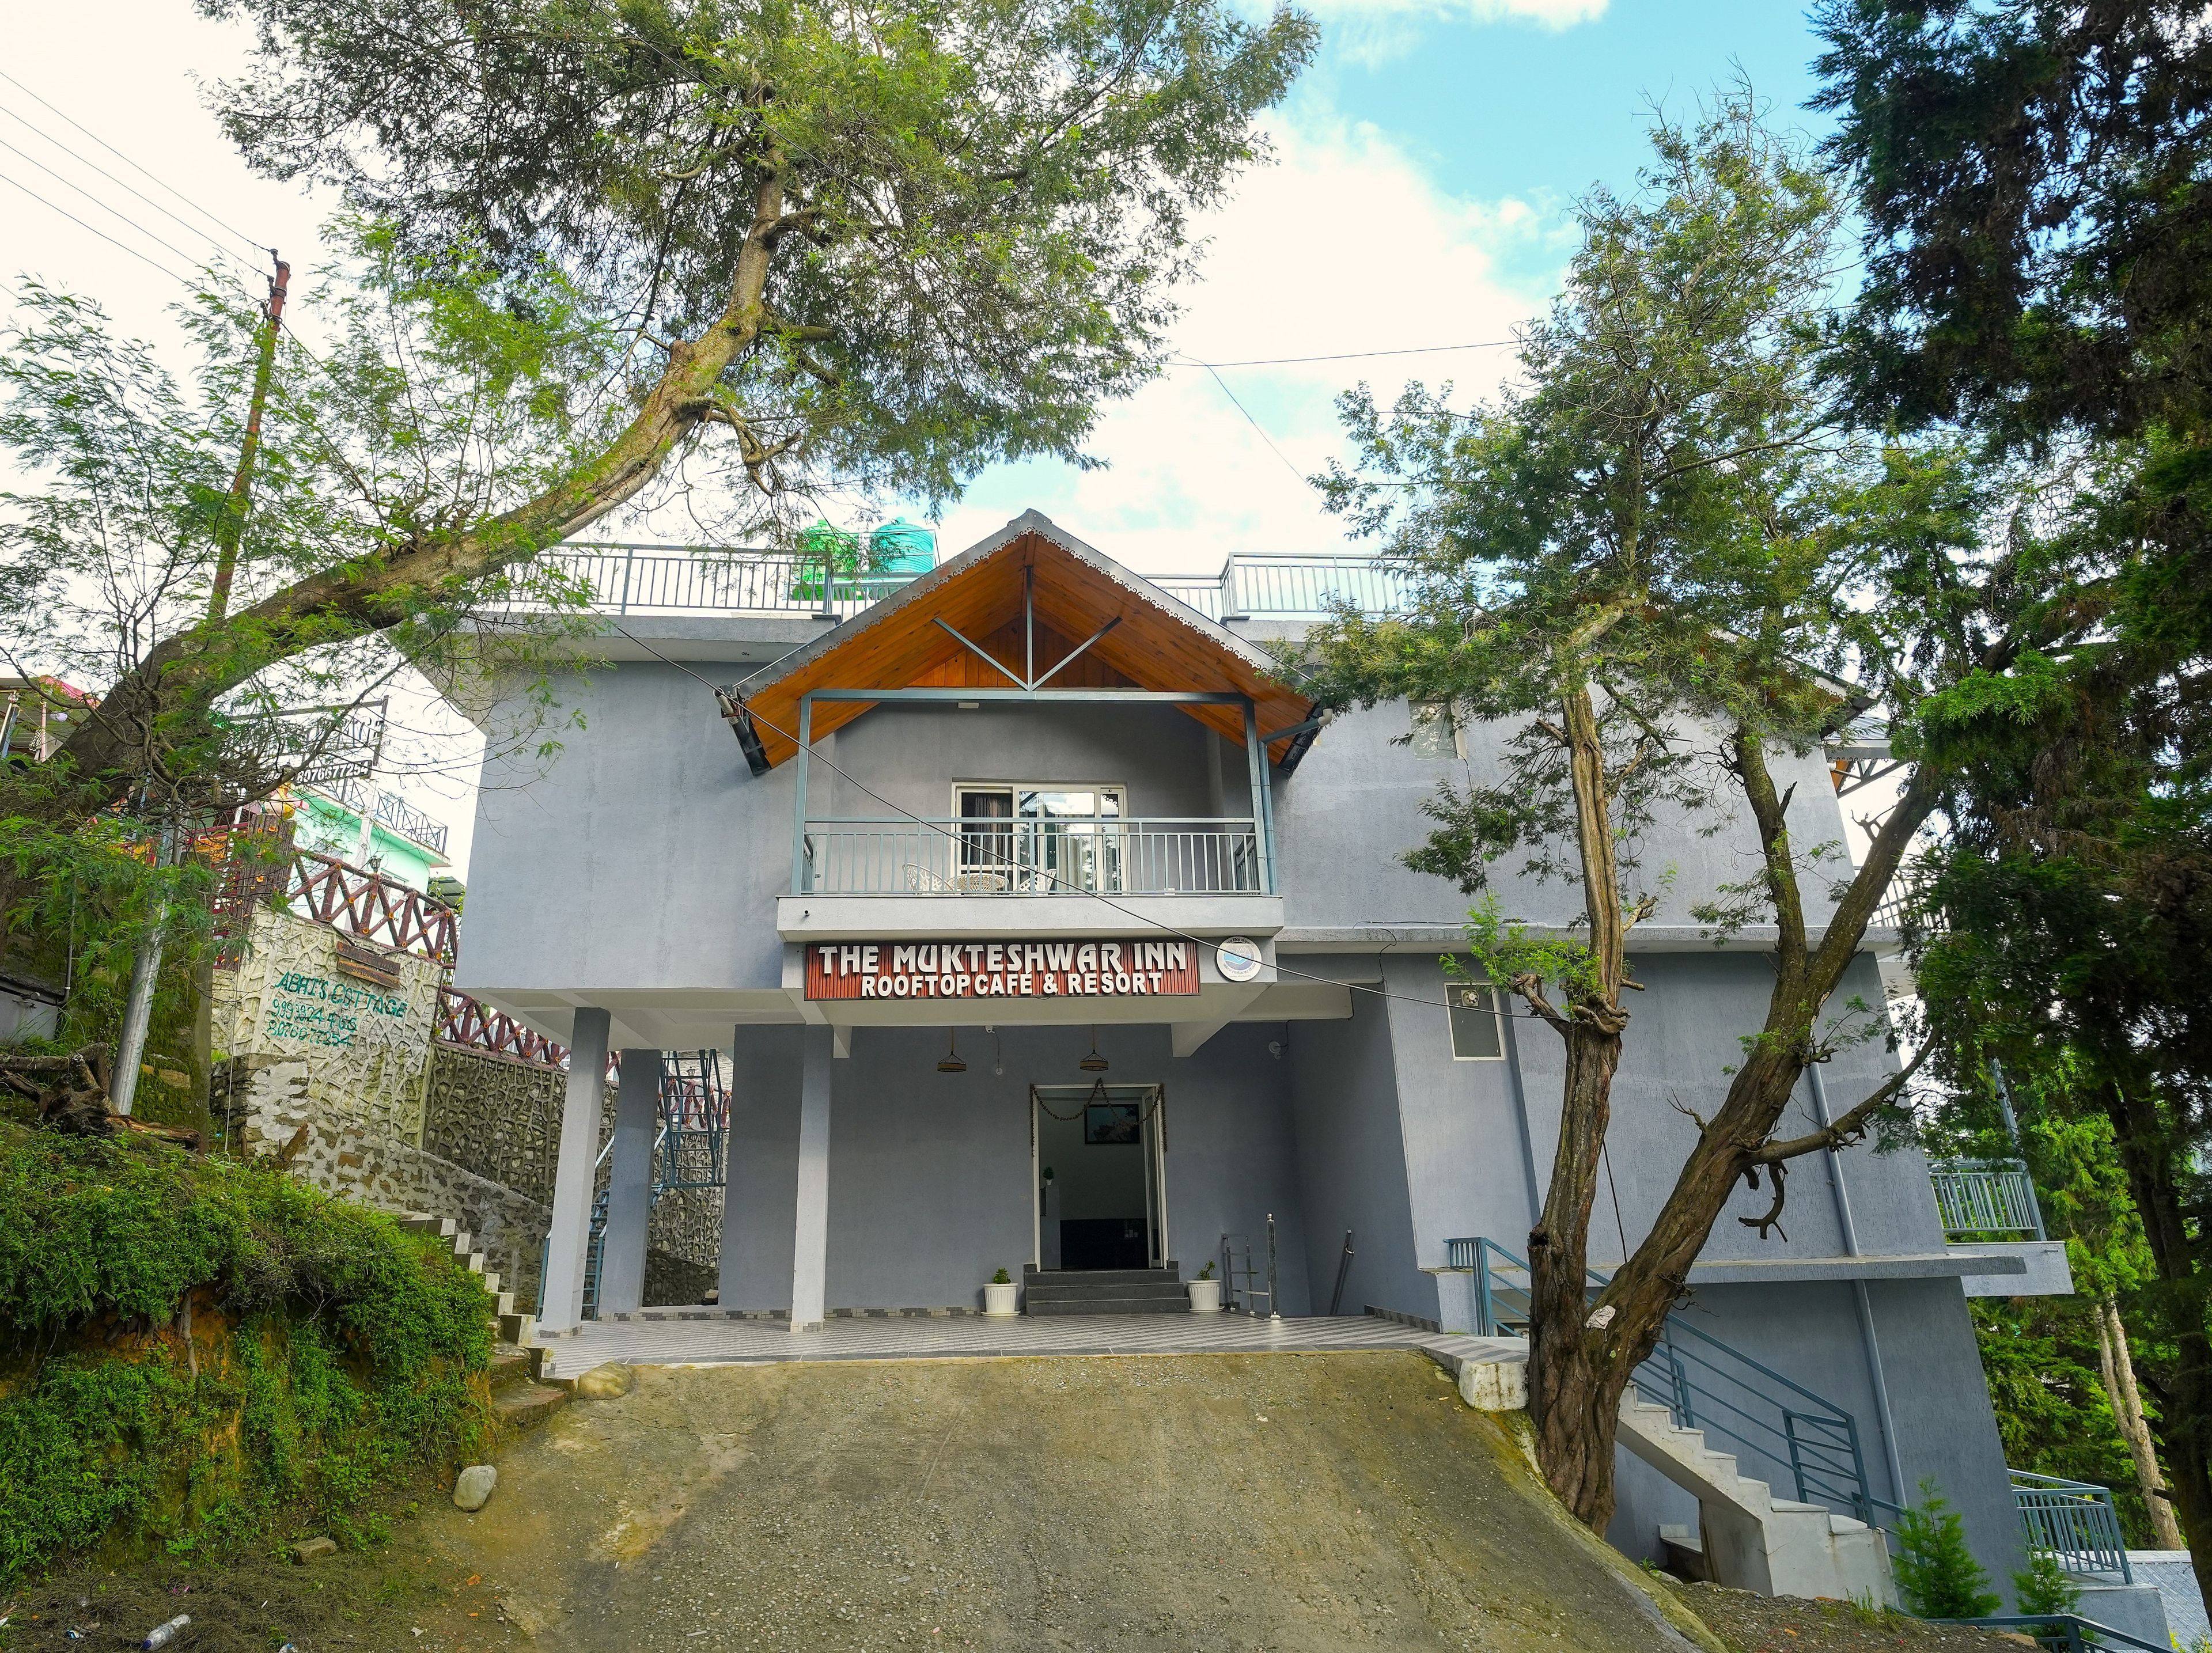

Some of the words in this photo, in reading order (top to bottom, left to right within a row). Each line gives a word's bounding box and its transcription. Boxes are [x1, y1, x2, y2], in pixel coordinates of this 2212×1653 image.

[818, 945, 879, 977] THE
[893, 943, 1124, 975] MUKTESHWAR
[1134, 942, 1186, 970] INN
[331, 983, 408, 1018] COTTAGE
[861, 974, 971, 997] ROOFTOP
[974, 973, 1033, 995] CAFE
[1043, 973, 1058, 994] &
[1067, 972, 1162, 994] RESORT
